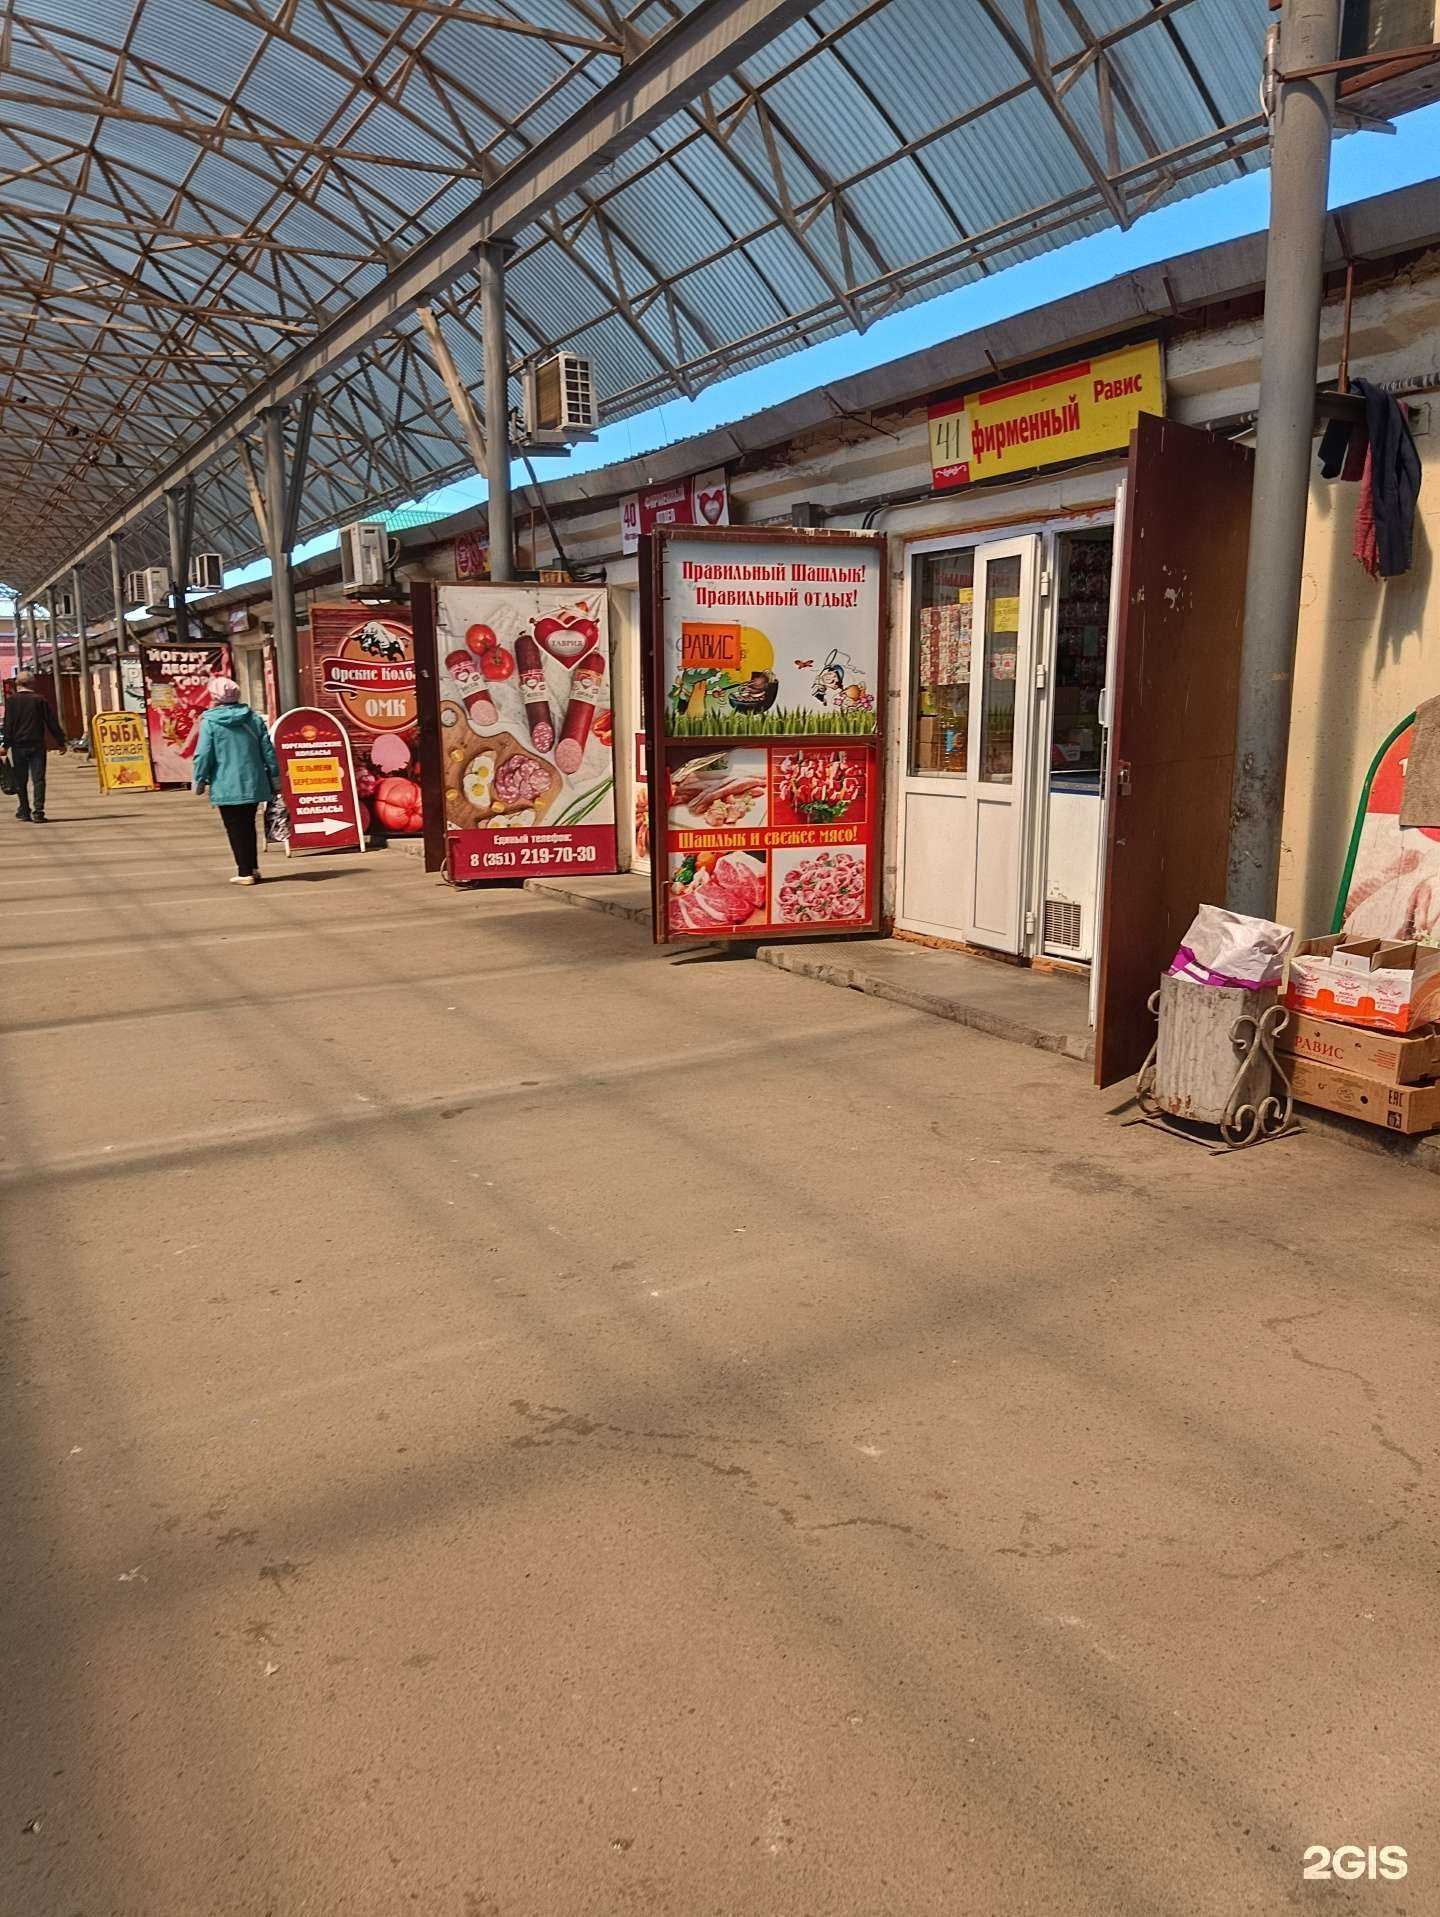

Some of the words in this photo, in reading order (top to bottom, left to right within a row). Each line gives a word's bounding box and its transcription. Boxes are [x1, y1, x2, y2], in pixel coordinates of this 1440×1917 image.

[1093, 374, 1143, 403] Равис
[936, 418, 960, 459] 41
[970, 393, 1080, 465] фирменный
[623, 502, 637, 528] 40
[682, 561, 785, 582] Правильный
[791, 563, 866, 583] Шашлык!
[696, 587, 798, 608] Правильный
[804, 589, 858, 608] отдых!
[146, 648, 209, 662] ЙОГУРТ
[682, 634, 734, 660] РАВИС
[331, 667, 378, 682] Орские
[365, 699, 407, 717] ОМК
[100, 724, 141, 743] РЫБА
[296, 805, 344, 815] КОЛБАСЫ
[298, 795, 338, 804] ОРСКИЕ
[493, 835, 528, 845] Единый
[678, 832, 746, 849] Шашлык
[750, 834, 760, 845] и
[763, 831, 816, 846] свежее
[819, 826, 858, 843] мясо!
[470, 854, 479, 867] 8
[483, 852, 516, 867] (351)
[520, 846, 597, 865] 219-70-30
[1295, 1035, 1344, 1060] РАВИС
